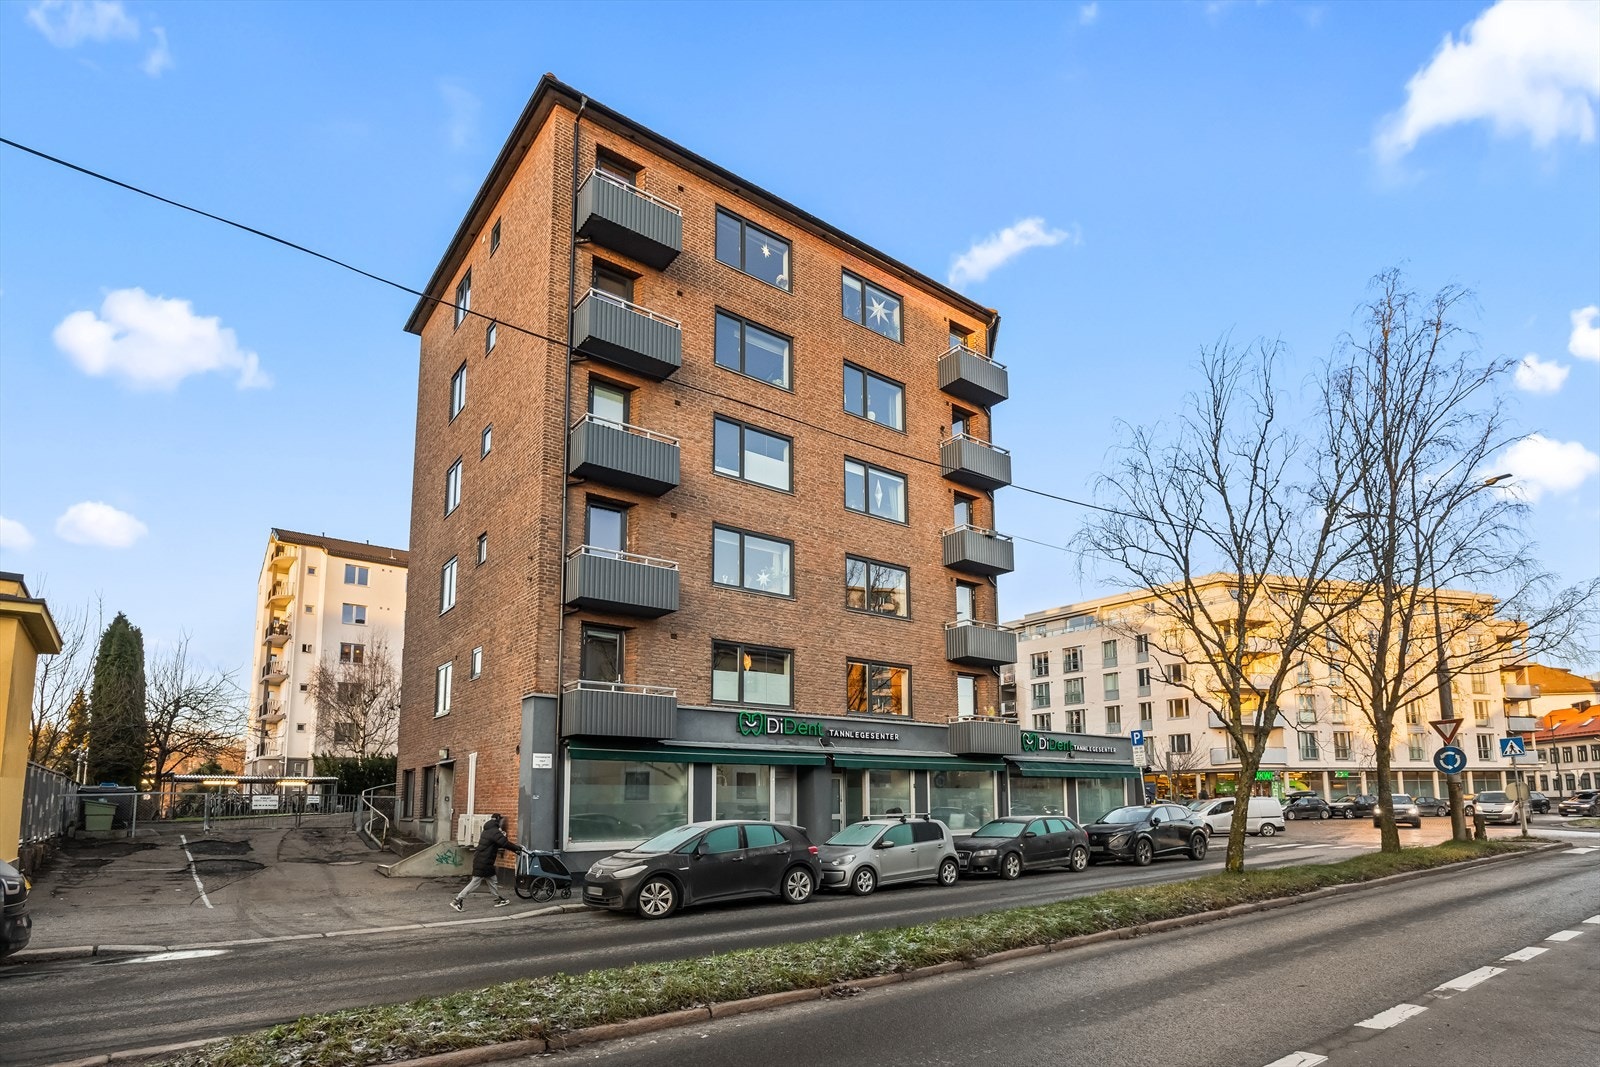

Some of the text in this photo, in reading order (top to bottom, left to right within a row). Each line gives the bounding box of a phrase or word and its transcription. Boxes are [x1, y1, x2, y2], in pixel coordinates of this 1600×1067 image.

[767, 717, 899, 741] DiDent TANNLEGESENTER
[1133, 732, 1141, 744] P
[1074, 744, 1116, 753] TANNLEGESENTER
